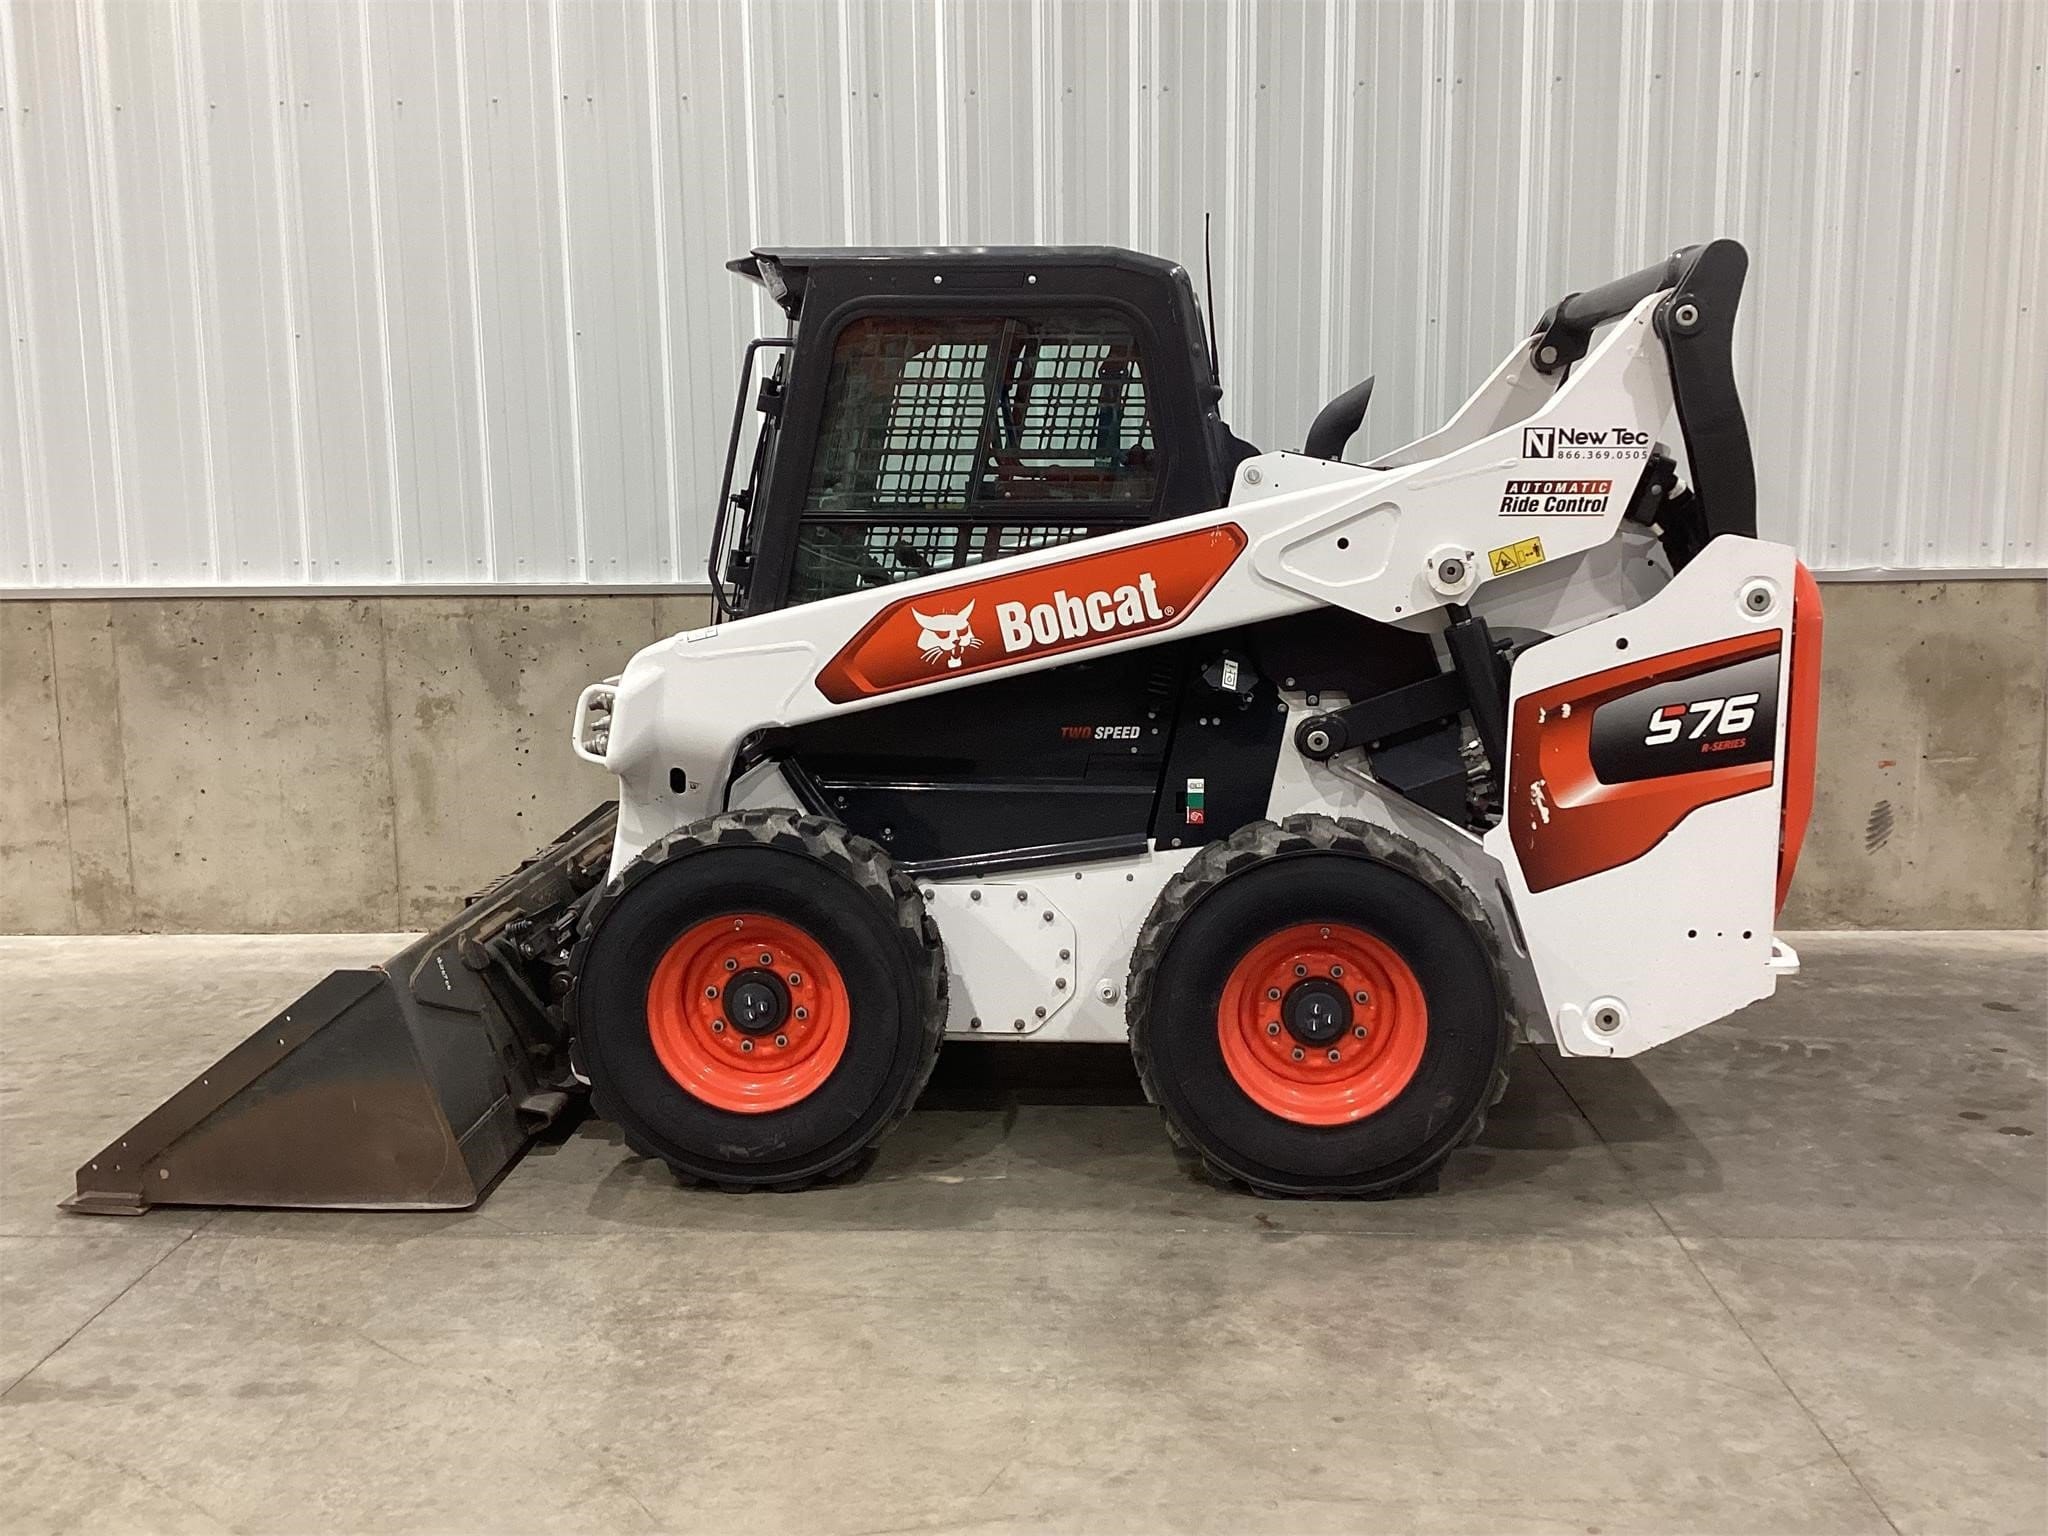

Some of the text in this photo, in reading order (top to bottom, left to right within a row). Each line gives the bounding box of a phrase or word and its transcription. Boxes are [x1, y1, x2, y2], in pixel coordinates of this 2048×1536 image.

[1558, 428, 1649, 445] New Tec
[1557, 451, 1648, 460] 866.369.0505
[1509, 482, 1610, 494] AUTOMATIC
[1500, 496, 1609, 513] Ride Control
[995, 572, 1164, 653] Bobcat
[1644, 693, 1760, 746] S76
[1060, 726, 1141, 739] TWO SPEED
[1701, 738, 1747, 753] R-SERIES
